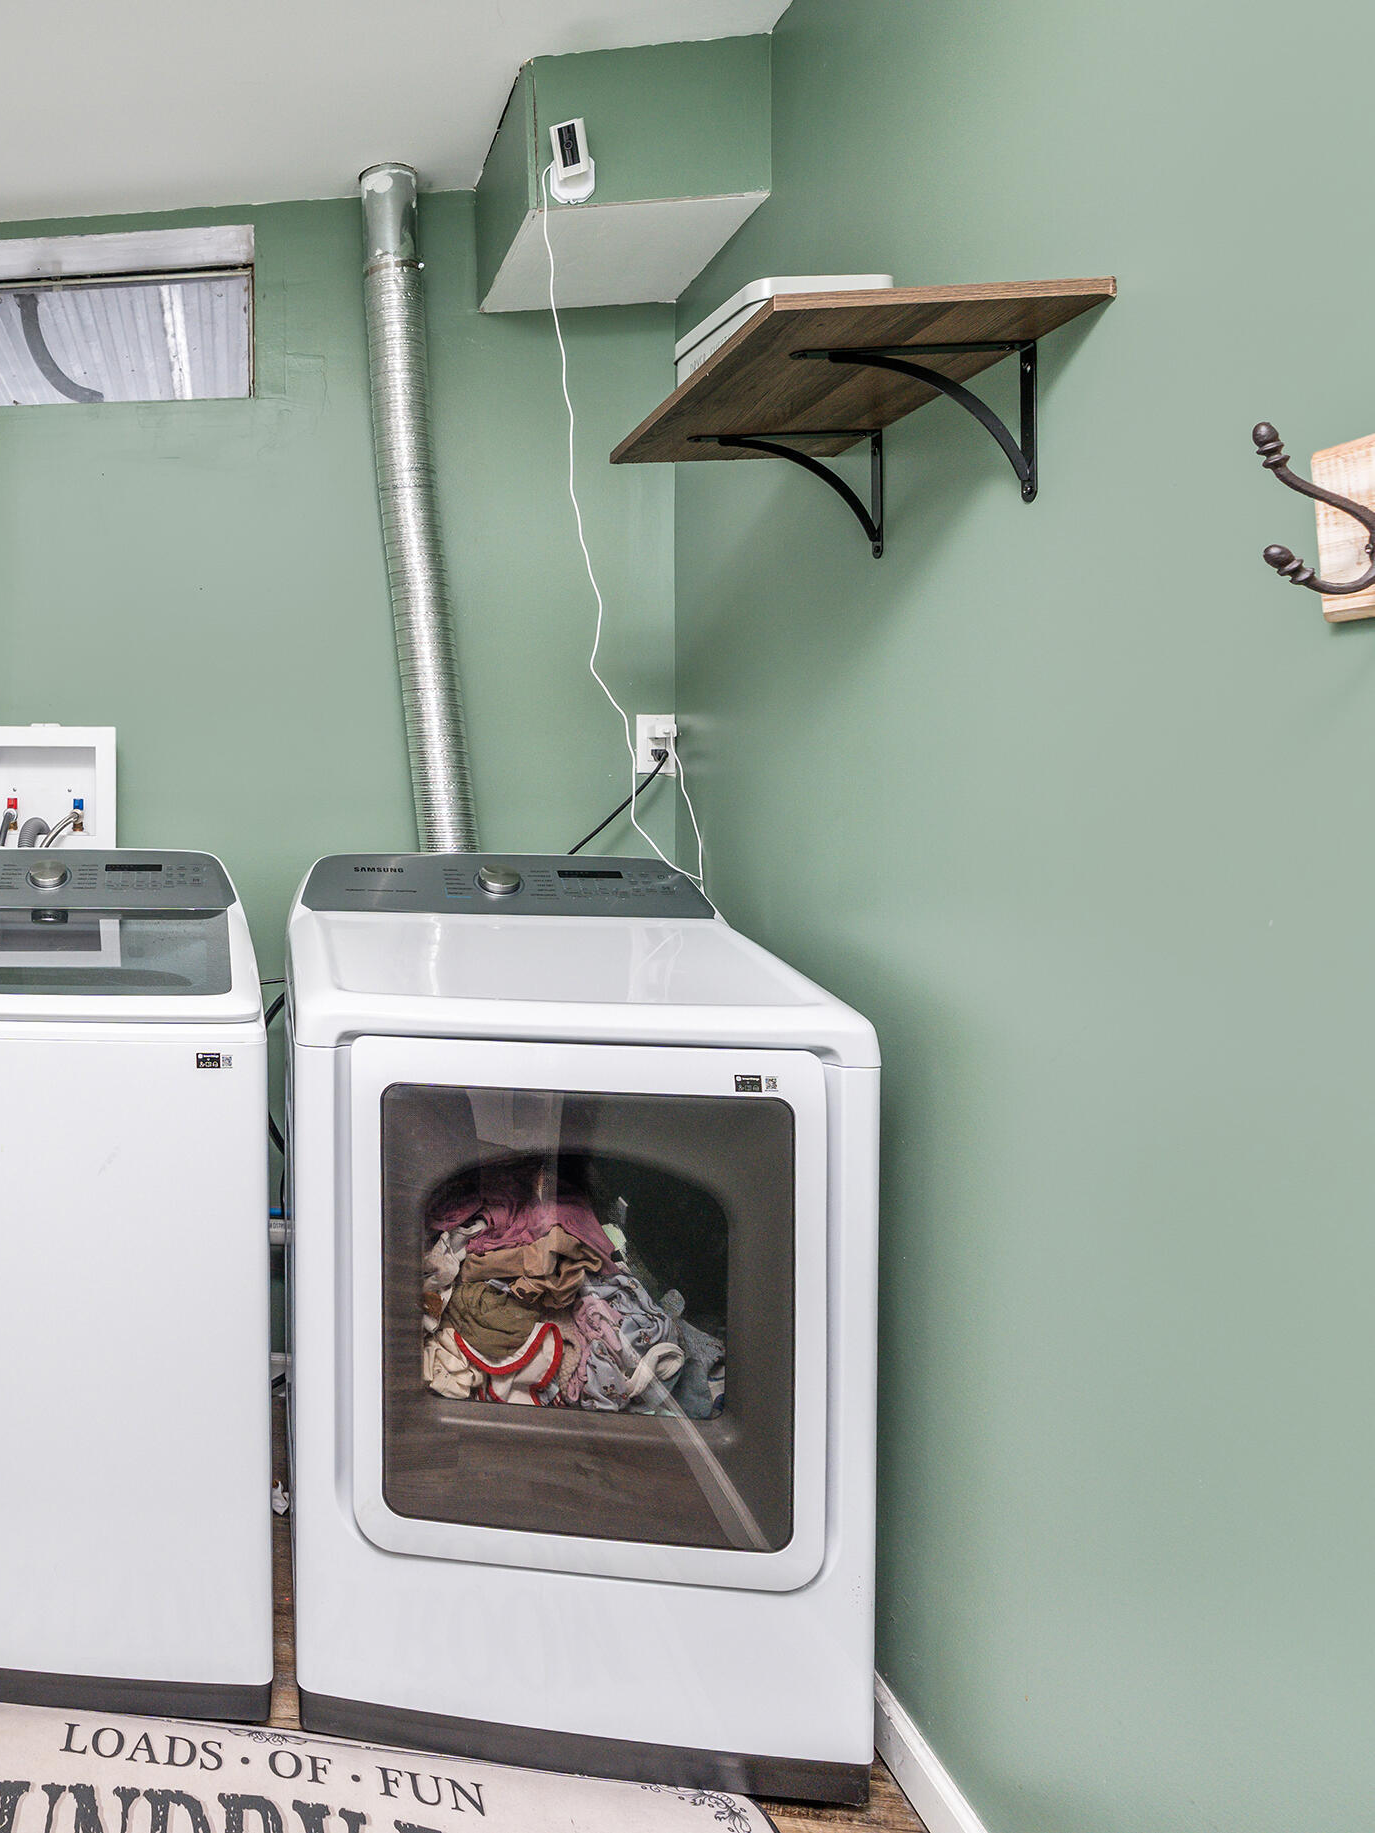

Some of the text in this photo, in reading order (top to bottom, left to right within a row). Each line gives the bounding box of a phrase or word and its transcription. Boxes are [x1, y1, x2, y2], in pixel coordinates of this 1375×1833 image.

[353, 866, 405, 874] SAMSUNG
[58, 1722, 224, 1771] LOADS
[268, 1750, 332, 1785] OF
[375, 1765, 486, 1817] FUN
